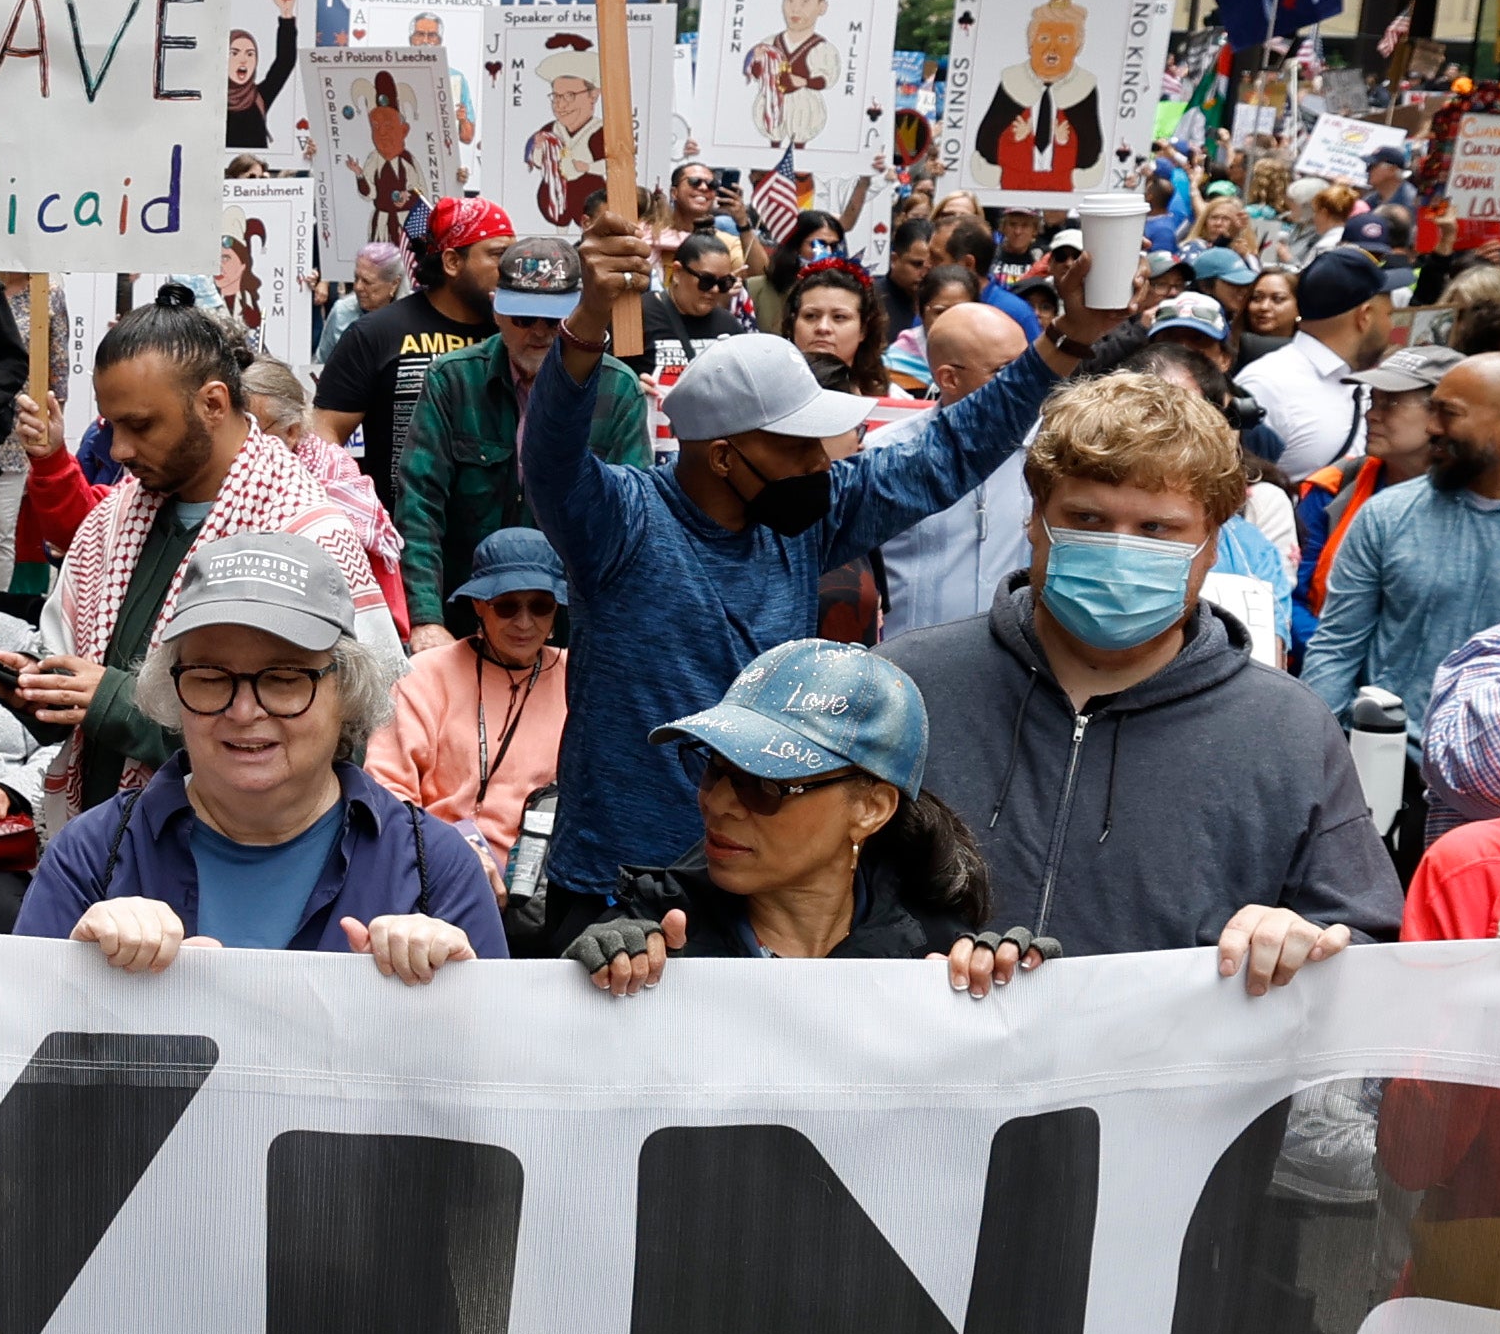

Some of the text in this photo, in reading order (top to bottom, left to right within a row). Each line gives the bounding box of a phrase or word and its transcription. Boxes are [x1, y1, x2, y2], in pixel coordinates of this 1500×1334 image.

[354, 10, 367, 25] A
[505, 10, 593, 25] Speaker of the
[310, 49, 438, 64] Sec. of Potions & Leeches
[486, 33, 500, 54] J
[845, 20, 863, 96] MILLER
[1118, 1, 1152, 120] NO KINGS
[511, 58, 526, 107] MIKE
[324, 76, 340, 149] ROBERT
[942, 56, 971, 173] KINGS NO
[233, 184, 305, 198] Banishment
[271, 267, 286, 317] NOEM
[73, 315, 85, 375] RUBIO
[209, 555, 309, 579] INDIVISIBLE
[225, 568, 288, 582] CHICAGO
[780, 682, 850, 716] Love
[760, 731, 824, 769] Love
